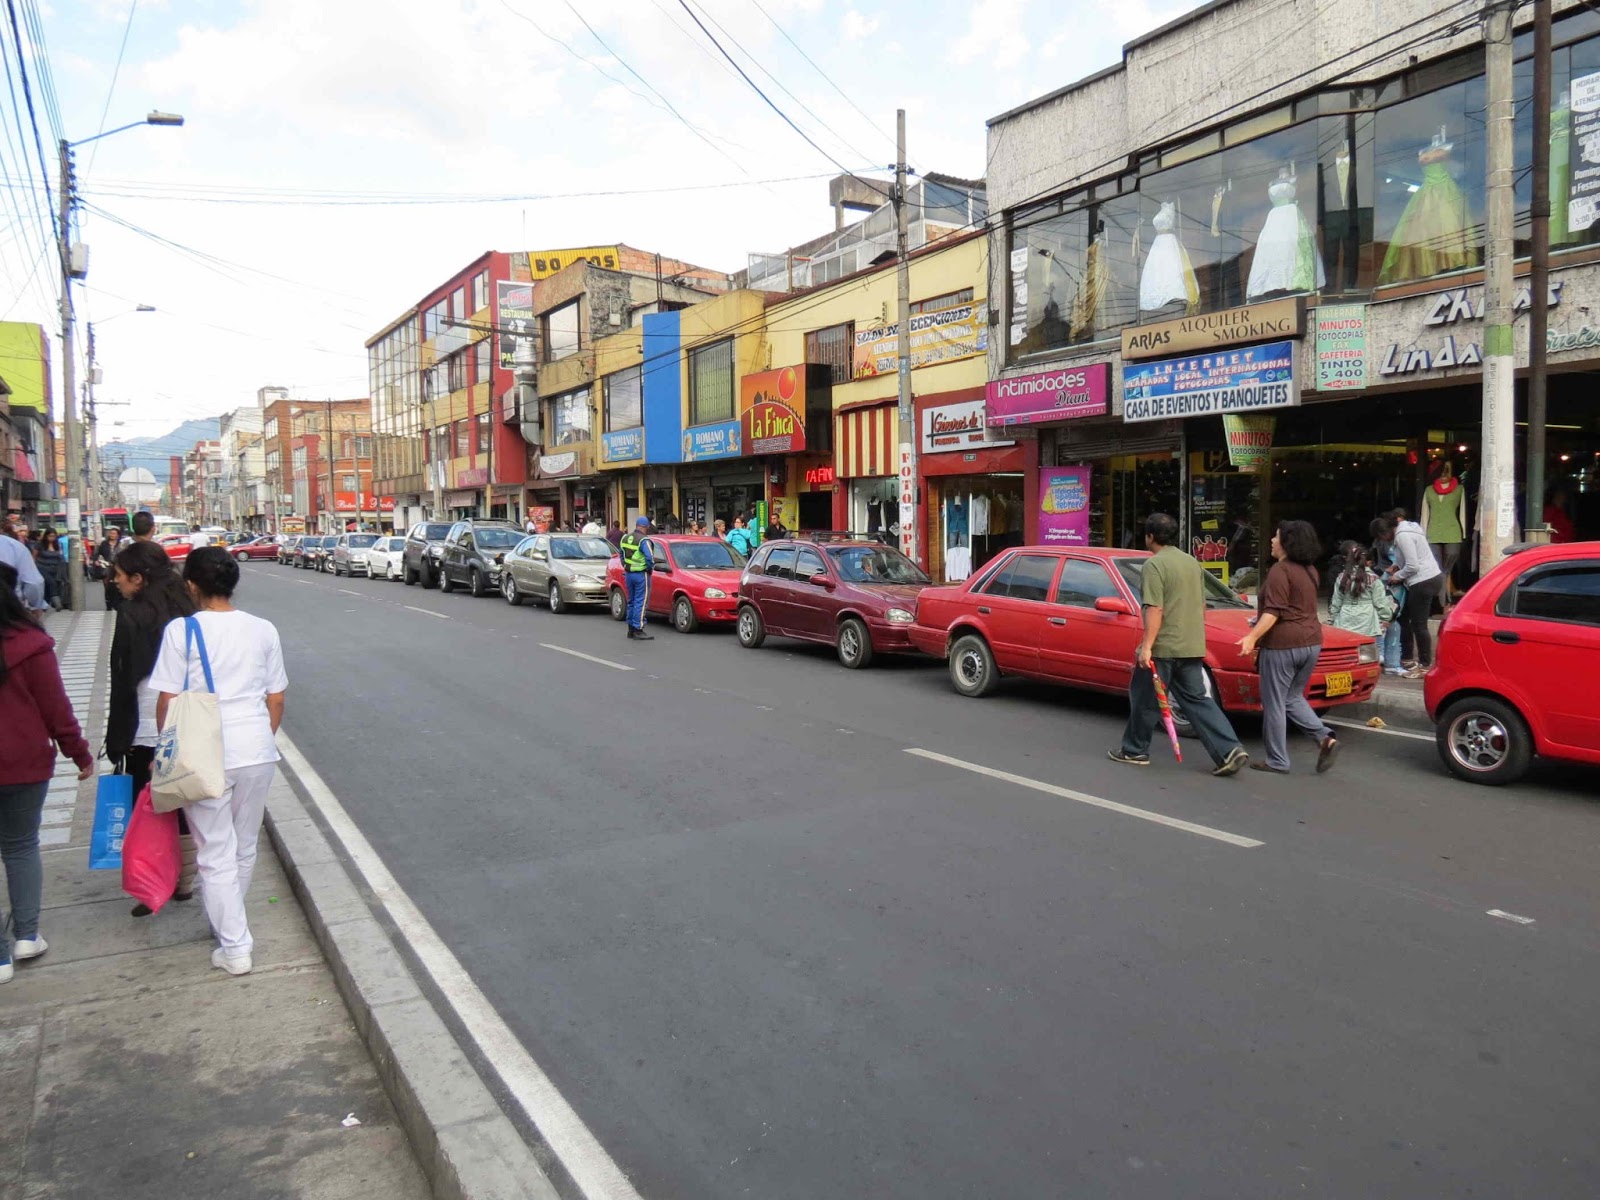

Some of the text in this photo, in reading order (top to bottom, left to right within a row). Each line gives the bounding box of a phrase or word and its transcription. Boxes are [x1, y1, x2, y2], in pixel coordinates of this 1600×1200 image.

[1574, 166, 1600, 180] Doming
[911, 306, 973, 332] ECEPCIONES
[1319, 307, 1361, 318] INTERNET
[1179, 310, 1250, 333] ALQUILER
[1318, 318, 1363, 331] MINUTOS
[1129, 317, 1290, 350] ARIAS SMOKING
[1317, 330, 1364, 341] FOTOCOPIAS
[1332, 341, 1350, 350] FAX
[1319, 349, 1364, 360] CAFETERIA
[1379, 334, 1484, 376] Linda
[1155, 351, 1254, 377] INTERNET
[1174, 371, 1203, 382] LOCAL
[1208, 357, 1291, 378] INTERNACIONAL
[1320, 359, 1363, 370] TINTO
[1334, 368, 1363, 378] 400
[997, 371, 1086, 398] Intimidades
[1173, 376, 1231, 391] FOTOCOPIAS
[1126, 383, 1288, 419] CASA DE EVENTOS Y BANQUETES
[749, 406, 794, 440] La Finca
[695, 429, 725, 446] ROMANO
[1230, 431, 1272, 447] MINUTOS
[817, 467, 833, 482] FIN
